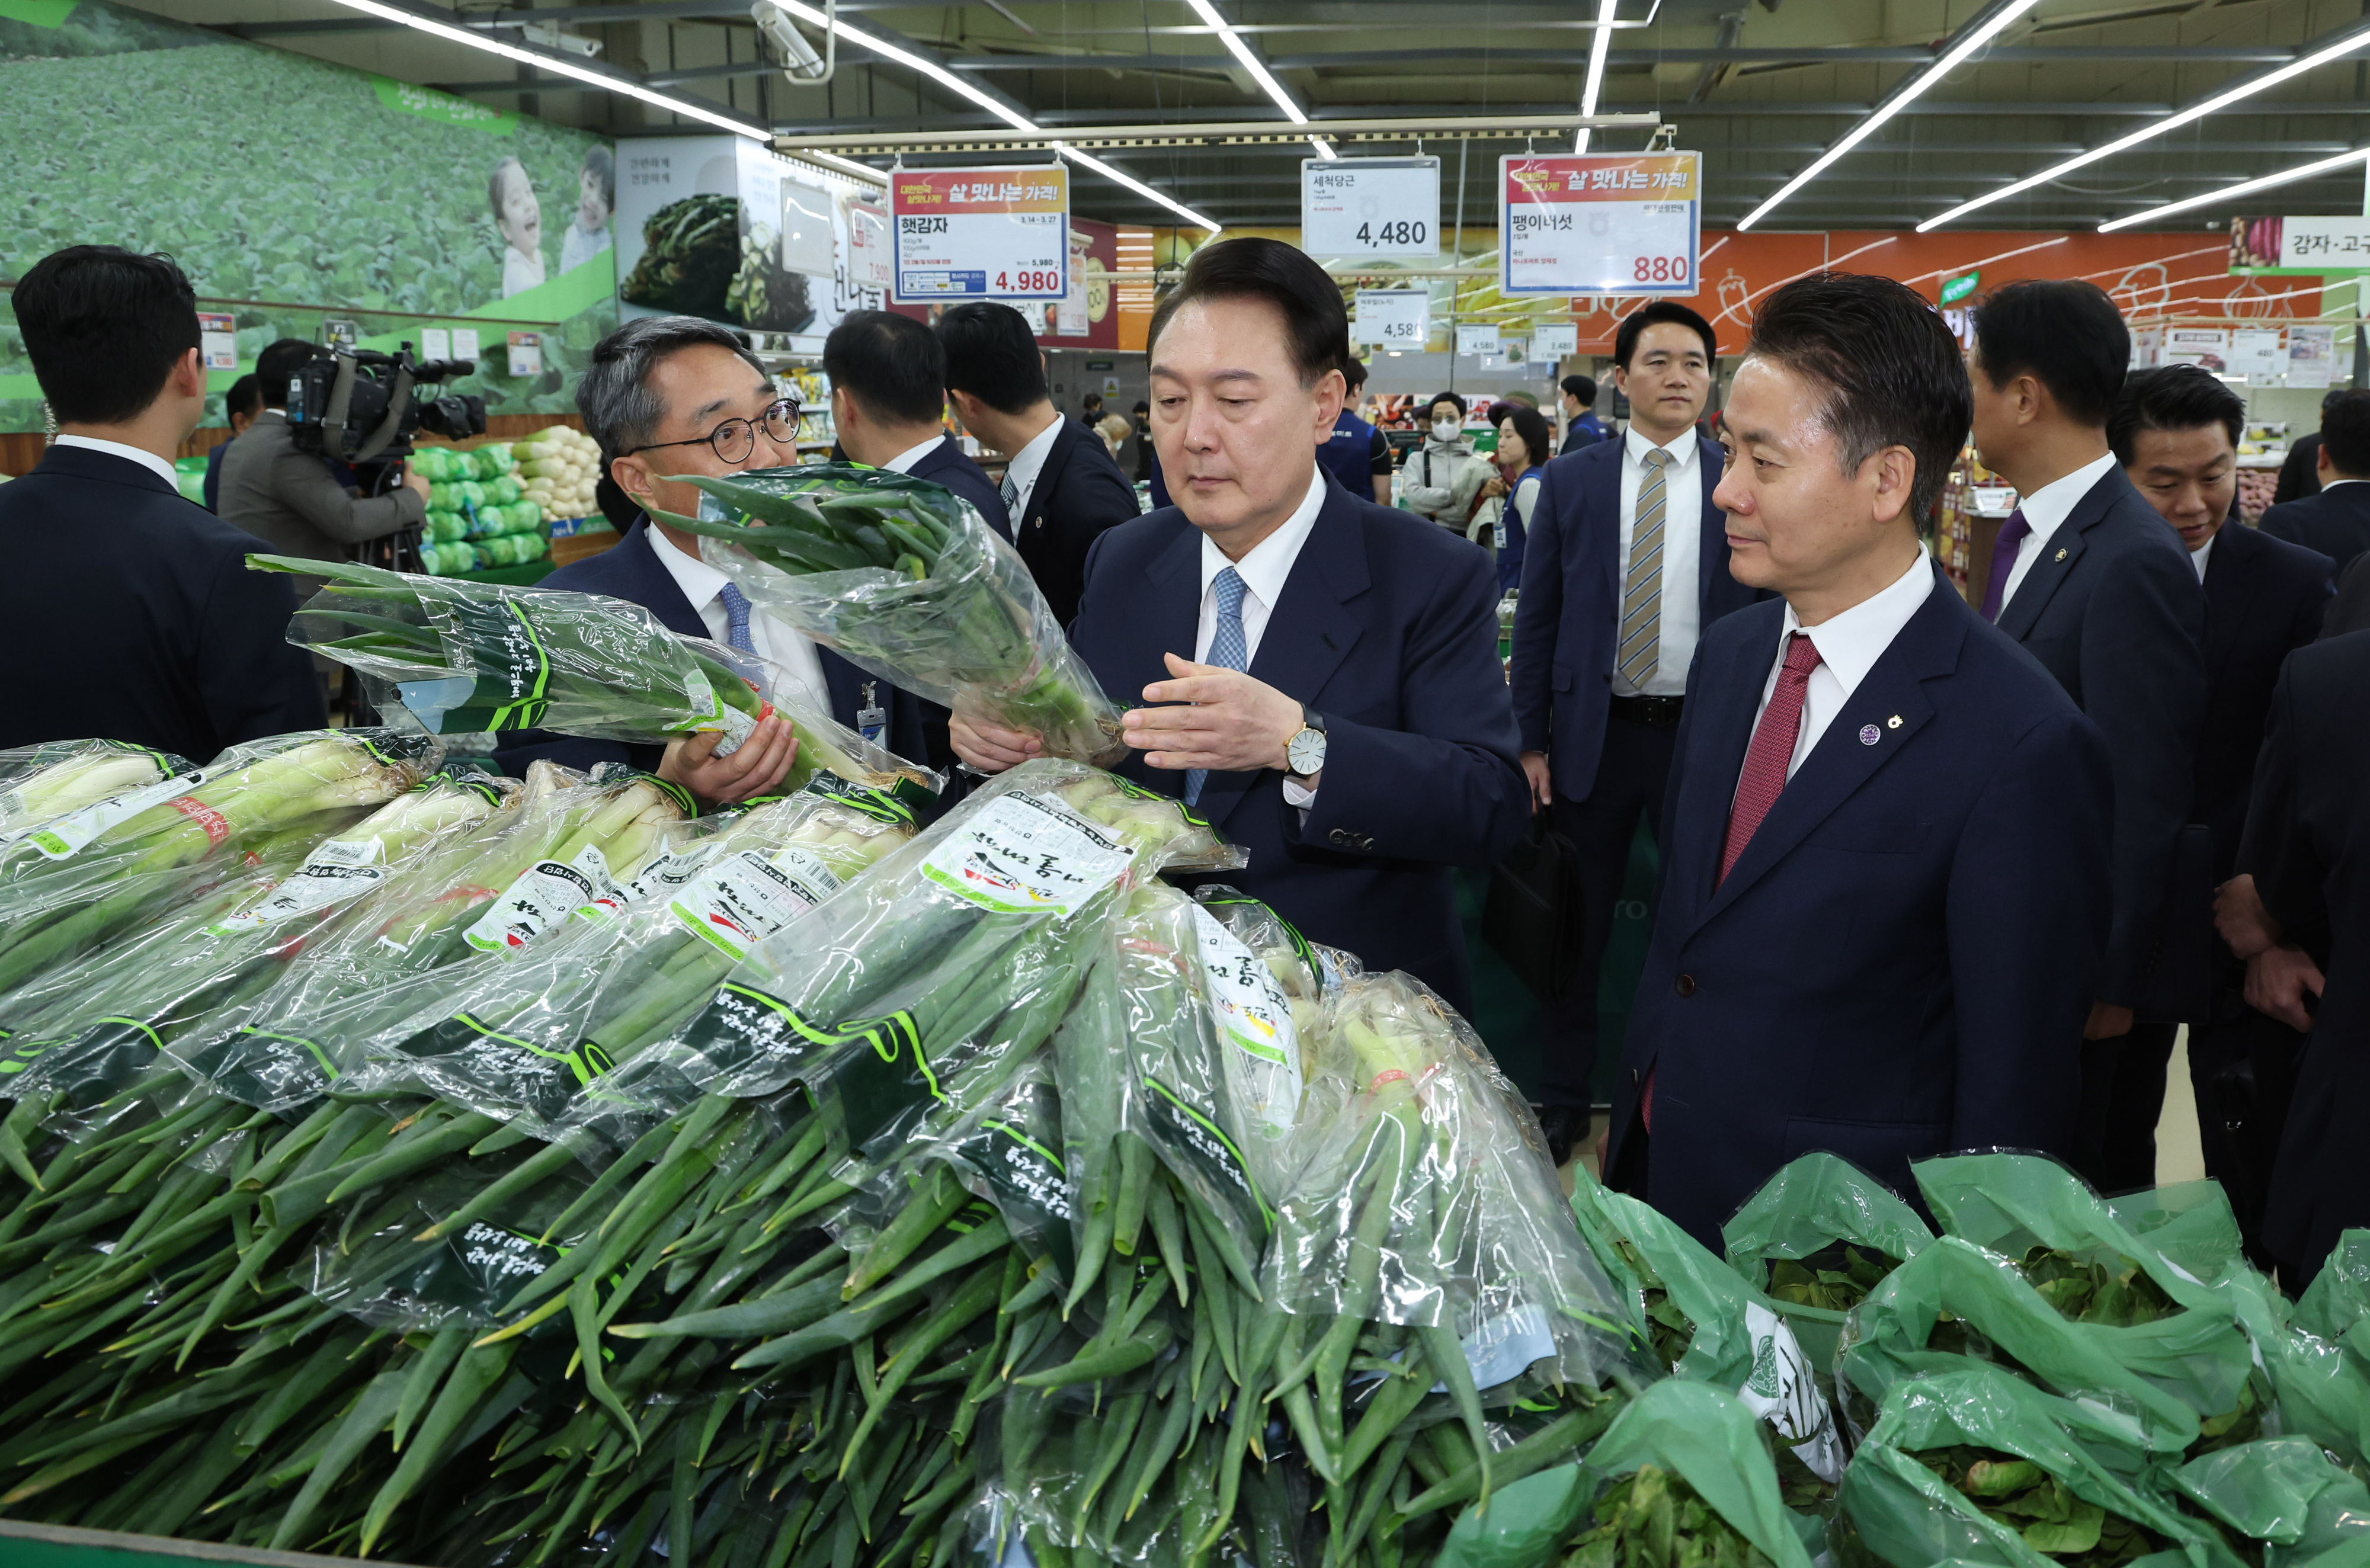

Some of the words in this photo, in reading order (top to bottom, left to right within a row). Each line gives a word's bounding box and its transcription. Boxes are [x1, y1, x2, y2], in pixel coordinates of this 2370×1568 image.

[900, 184, 932, 194] 대한민국
[1313, 175, 1355, 187] 세척당근
[1568, 171, 1589, 191] 살
[1591, 169, 1648, 190] 맛나는
[1651, 171, 1689, 189] 가격!
[949, 184, 968, 203] 살
[971, 182, 1023, 202] 맛나는
[1025, 184, 1059, 201] 가격!
[901, 217, 949, 234] 햇감자
[1512, 214, 1572, 230] 팽이버섯
[1356, 221, 1426, 248] 4,480
[1634, 256, 1687, 281] 880
[996, 271, 1058, 292] 4,980
[503, 635, 523, 660] 자란
[507, 624, 530, 651] 농산물
[523, 654, 537, 673] 우리
[510, 663, 524, 698] 해풍으로
[504, 925, 532, 942] 리랑
[716, 993, 758, 1018] 농산물
[721, 1014, 758, 1035] 자란
[756, 1015, 784, 1035] 우리
[265, 1042, 304, 1066] 농산물
[303, 1069, 324, 1088] 우리
[1005, 1145, 1046, 1178] 농산물
[1011, 1171, 1049, 1197] 자란
[463, 1222, 508, 1245] 농산물
[503, 1236, 533, 1253] 우리
[466, 1246, 505, 1266] 자란
